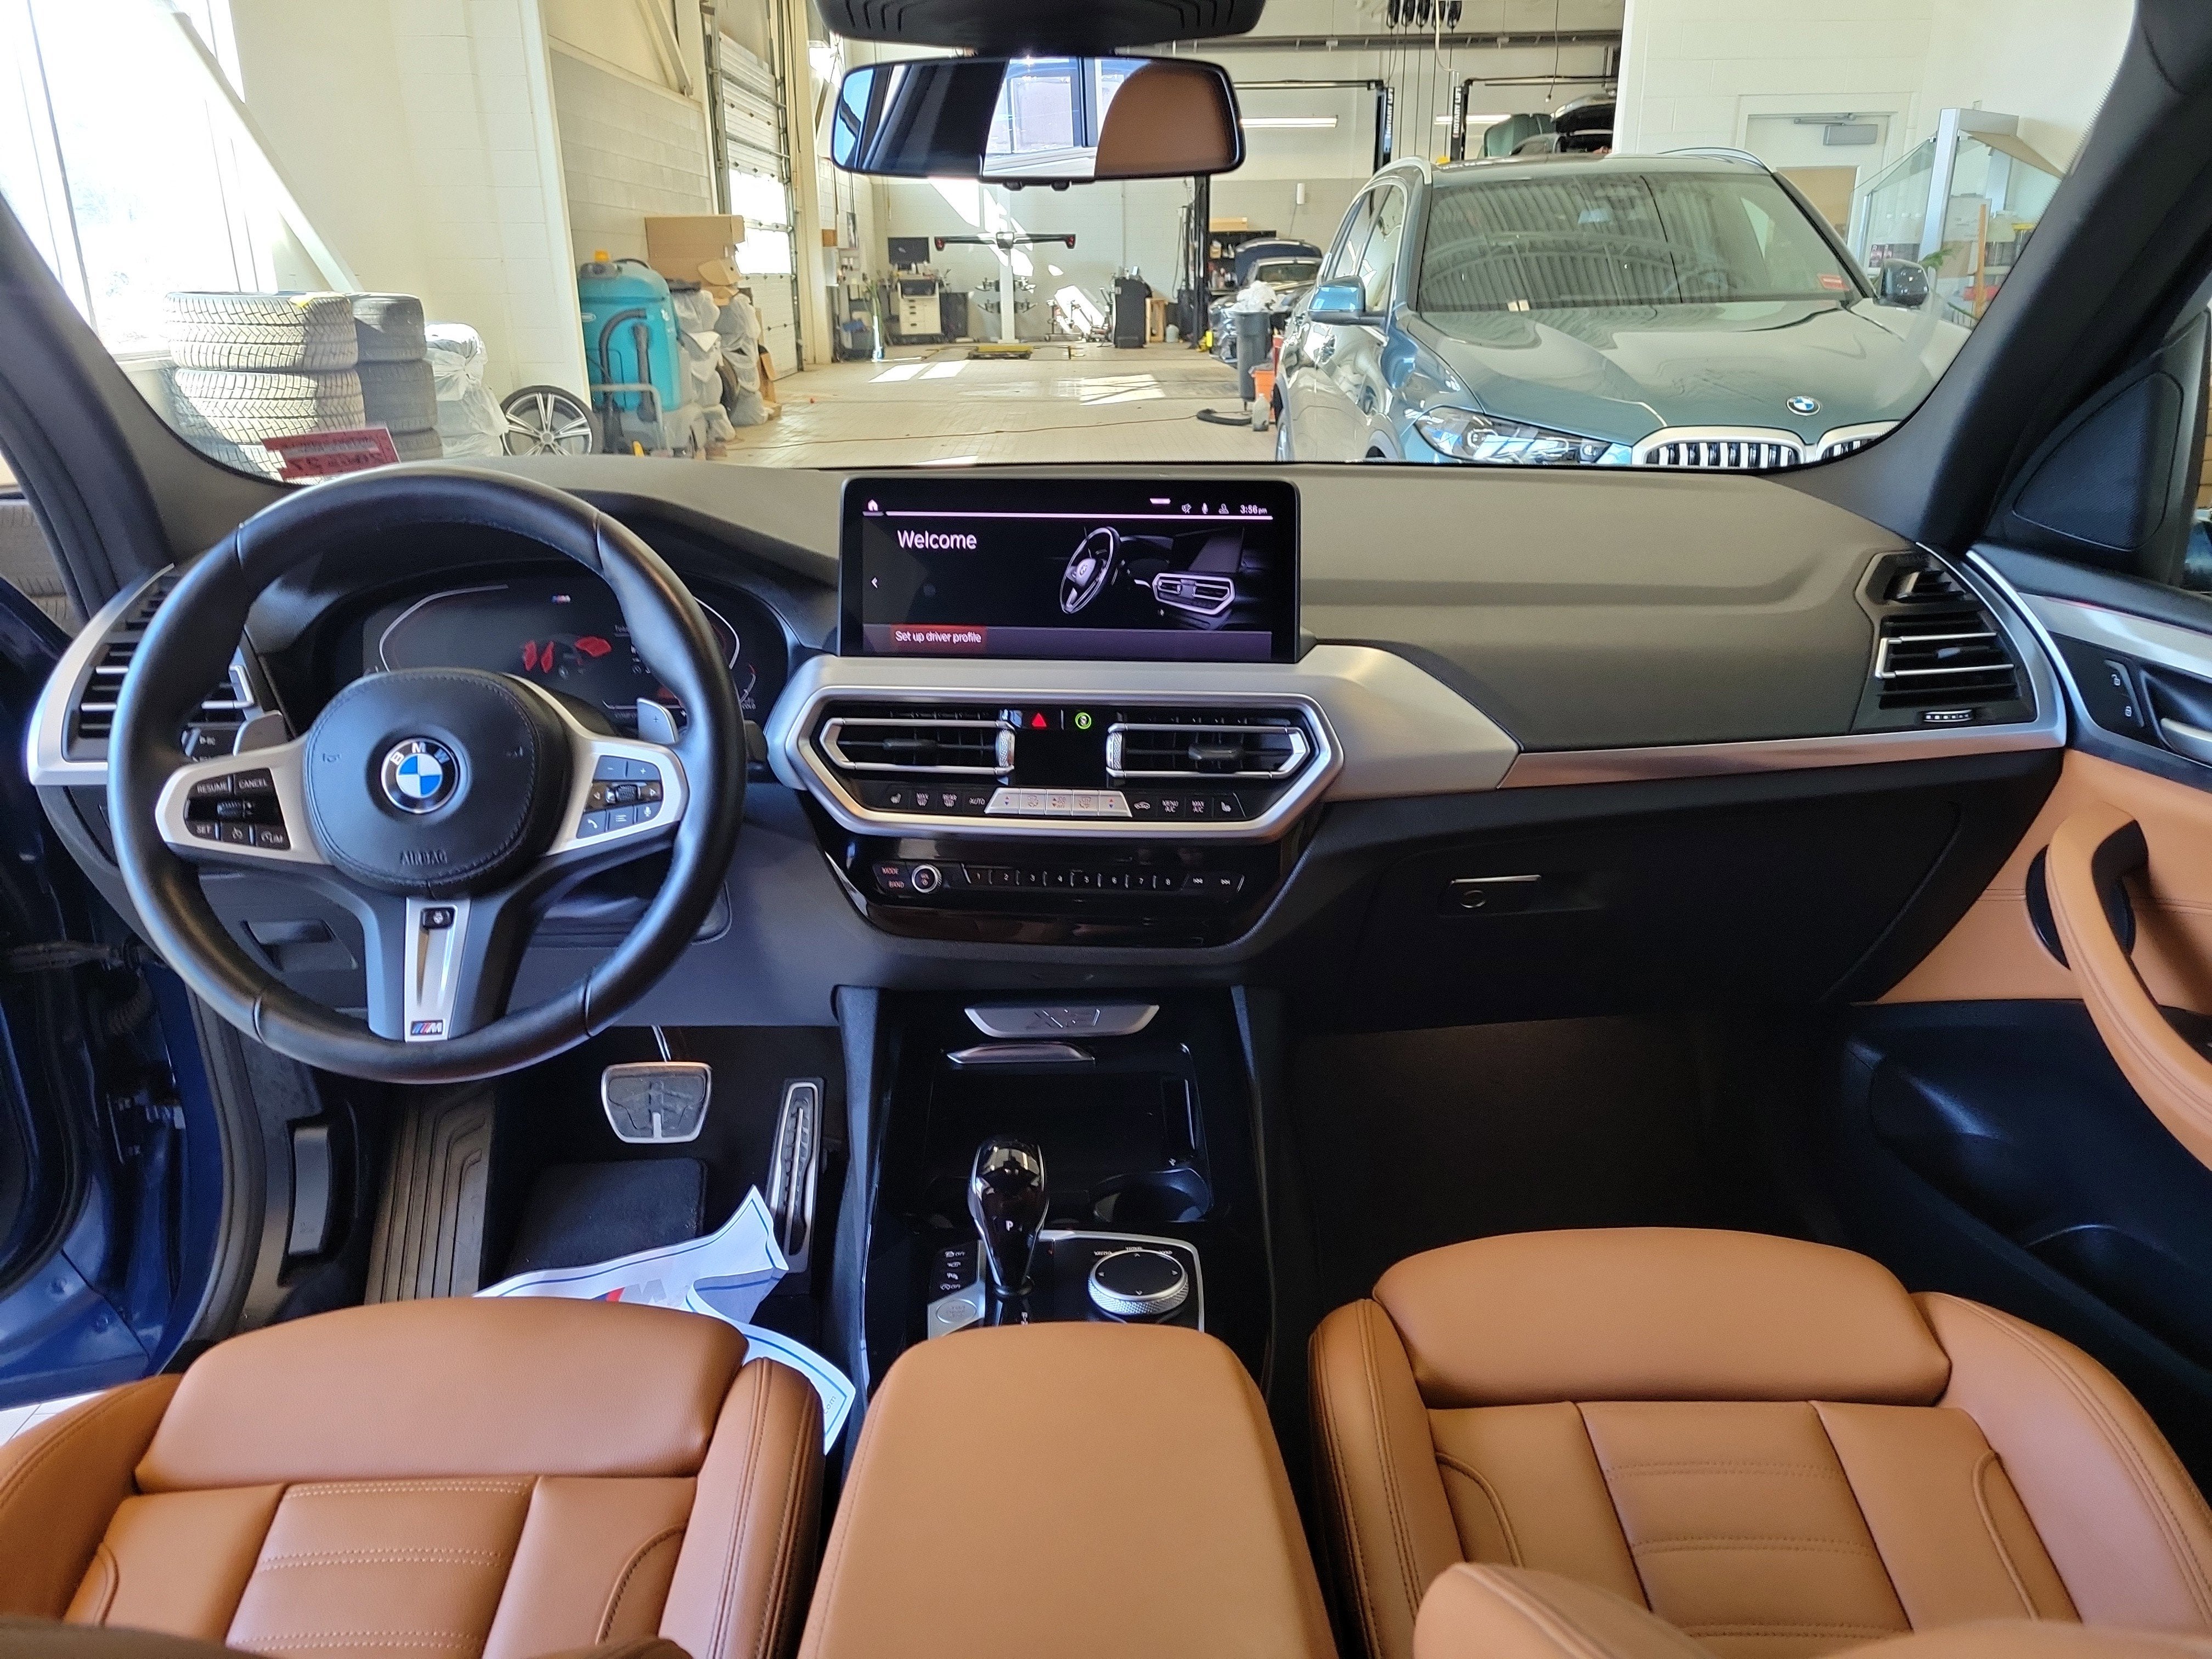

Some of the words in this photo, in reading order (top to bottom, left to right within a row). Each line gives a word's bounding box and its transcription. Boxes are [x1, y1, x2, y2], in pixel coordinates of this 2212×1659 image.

[897, 530, 977, 549] Welcome
[895, 630, 911, 641] Set
[912, 632, 924, 643] up
[926, 631, 952, 642] driver
[952, 631, 981, 644] profile
[390, 742, 450, 766] BMW
[196, 782, 228, 794] RESUME
[238, 778, 268, 789] CANCEL
[196, 825, 212, 834] SET
[400, 850, 447, 865] AIRBAG
[1006, 1220, 1014, 1232] P
